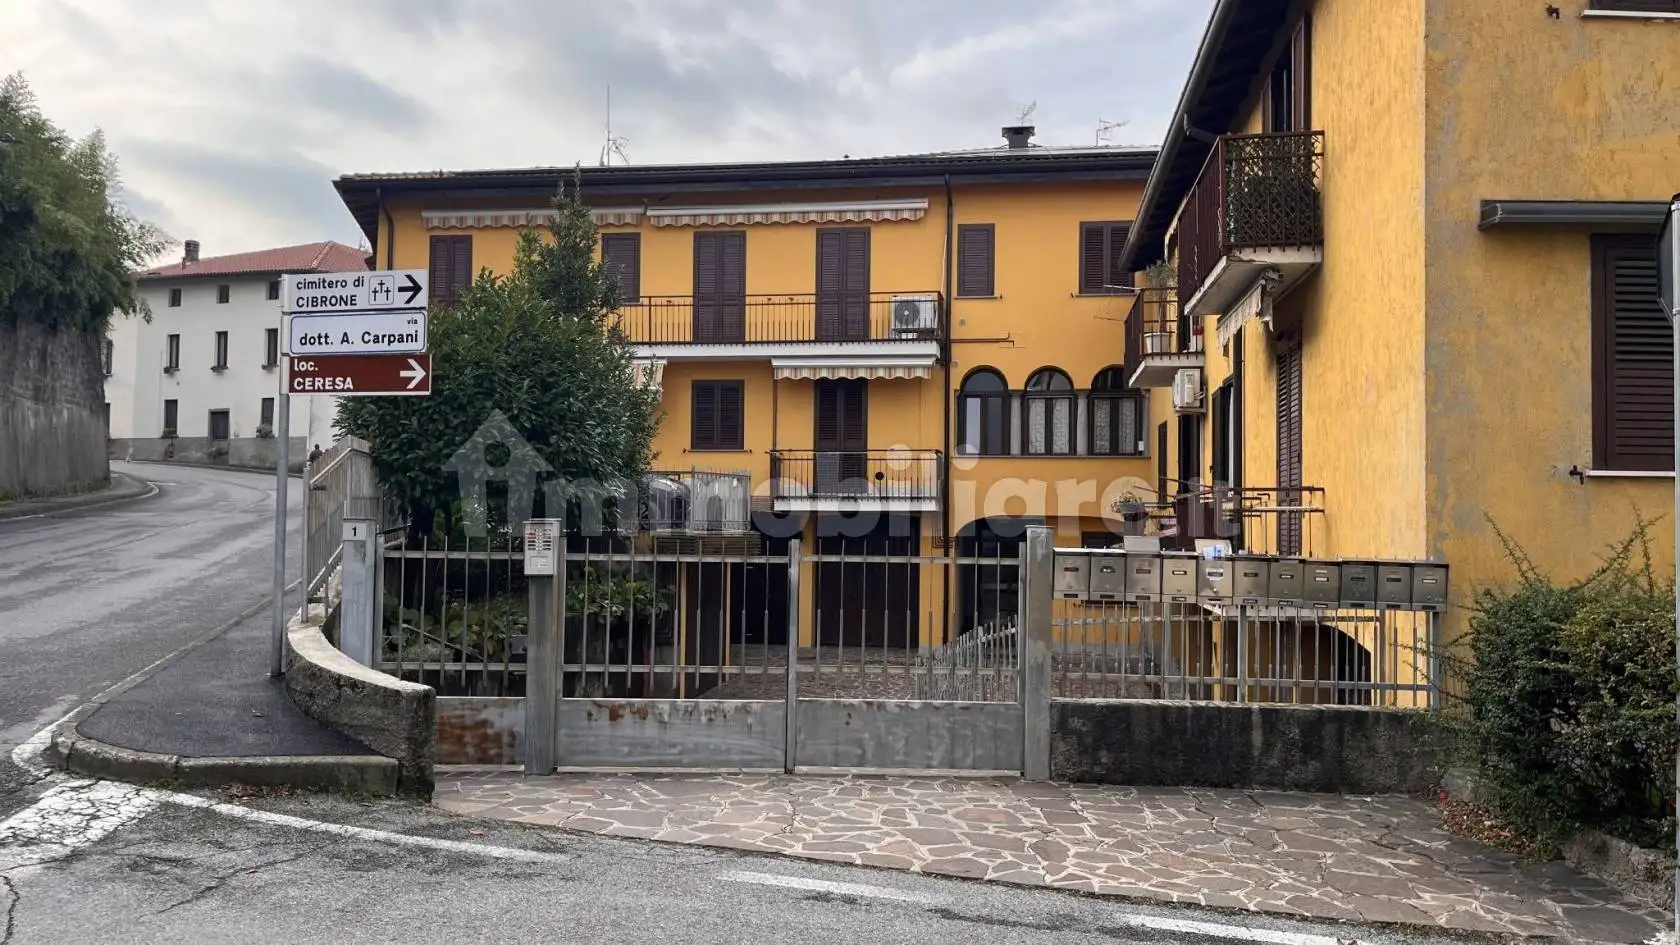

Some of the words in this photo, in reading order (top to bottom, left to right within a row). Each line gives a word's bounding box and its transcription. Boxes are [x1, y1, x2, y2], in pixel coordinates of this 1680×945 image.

[296, 277, 348, 290] cimitero
[353, 275, 364, 288] di
[296, 294, 357, 308] CIBRONE
[407, 317, 418, 325] via
[299, 332, 333, 346] dott.
[340, 331, 354, 345] A.
[361, 330, 418, 346] Carpani
[294, 358, 319, 371] loc.
[293, 376, 354, 390] CERESA
[351, 526, 357, 537] 1
